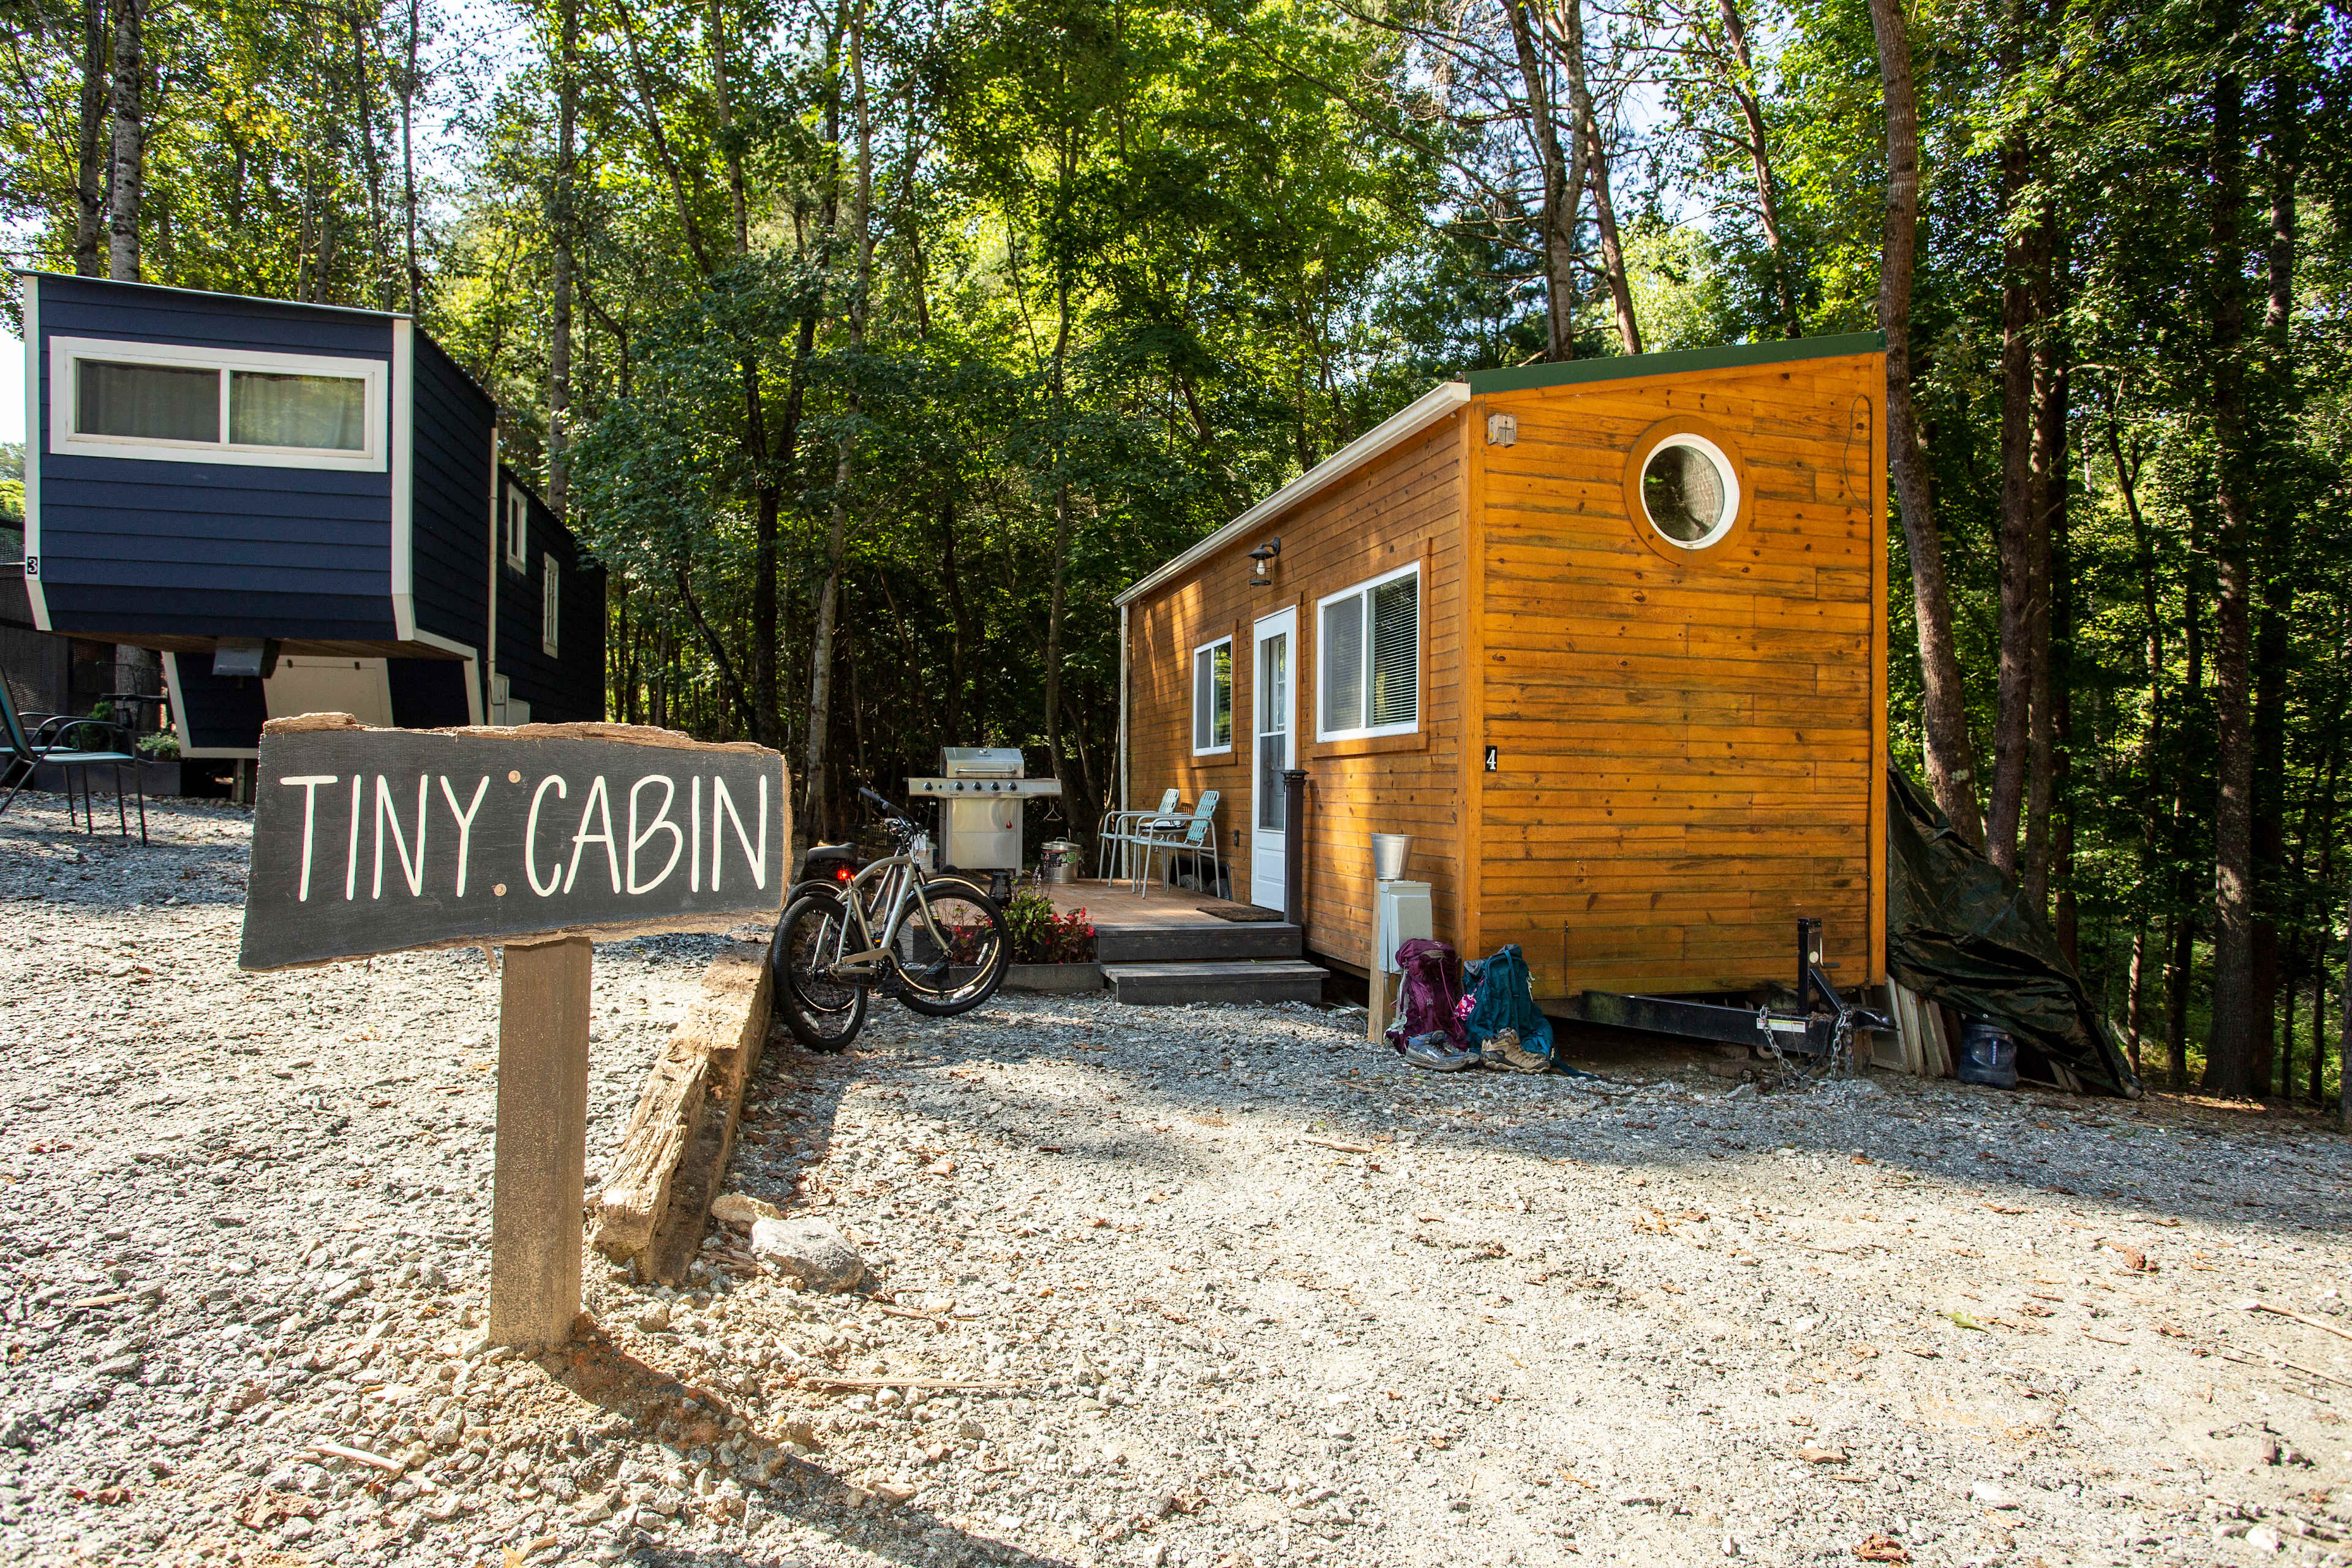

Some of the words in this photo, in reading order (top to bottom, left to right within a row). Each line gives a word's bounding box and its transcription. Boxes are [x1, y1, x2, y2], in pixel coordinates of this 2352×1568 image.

[28, 558, 37, 573] 3
[1486, 749, 1496, 770] 4
[280, 774, 490, 902] TINY
[525, 774, 767, 897] CABIN
